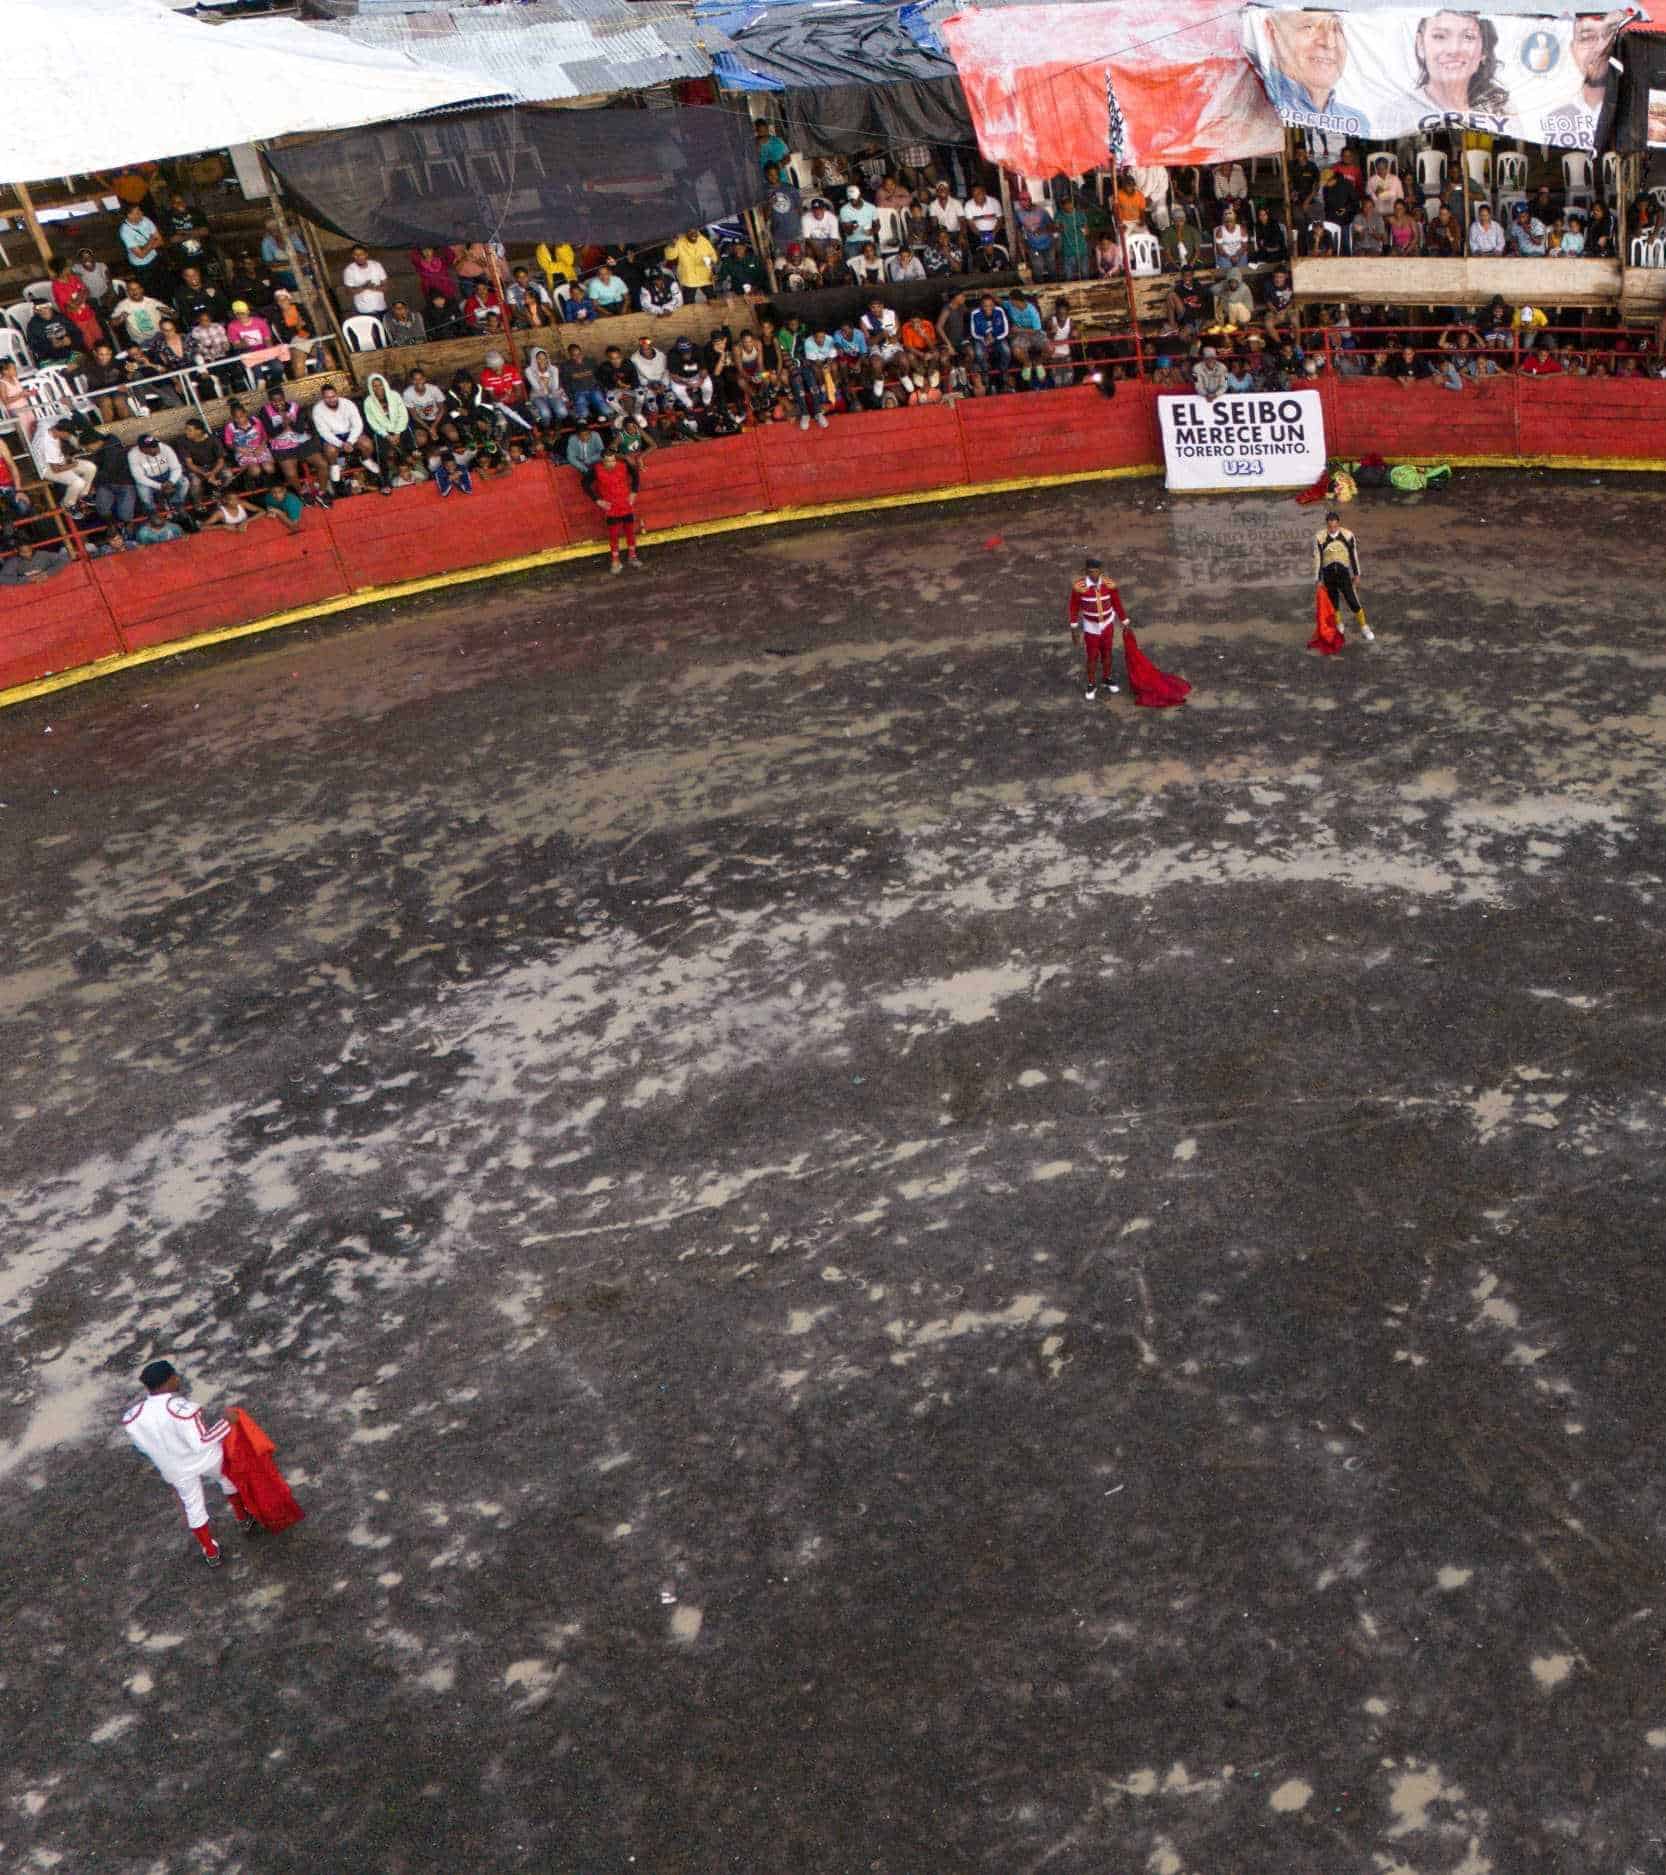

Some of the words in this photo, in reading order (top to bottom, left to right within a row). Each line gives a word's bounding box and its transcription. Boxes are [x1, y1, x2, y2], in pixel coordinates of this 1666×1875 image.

[1417, 111, 1509, 133] GREY
[1172, 403, 1204, 426] EL
[1212, 399, 1302, 426] SEIBO
[1176, 426, 1262, 445] MERECE
[1270, 424, 1305, 442] UN
[1175, 445, 1235, 458] TORERO
[1239, 442, 1310, 456] DISTINTO.
[1222, 460, 1264, 476] U24
